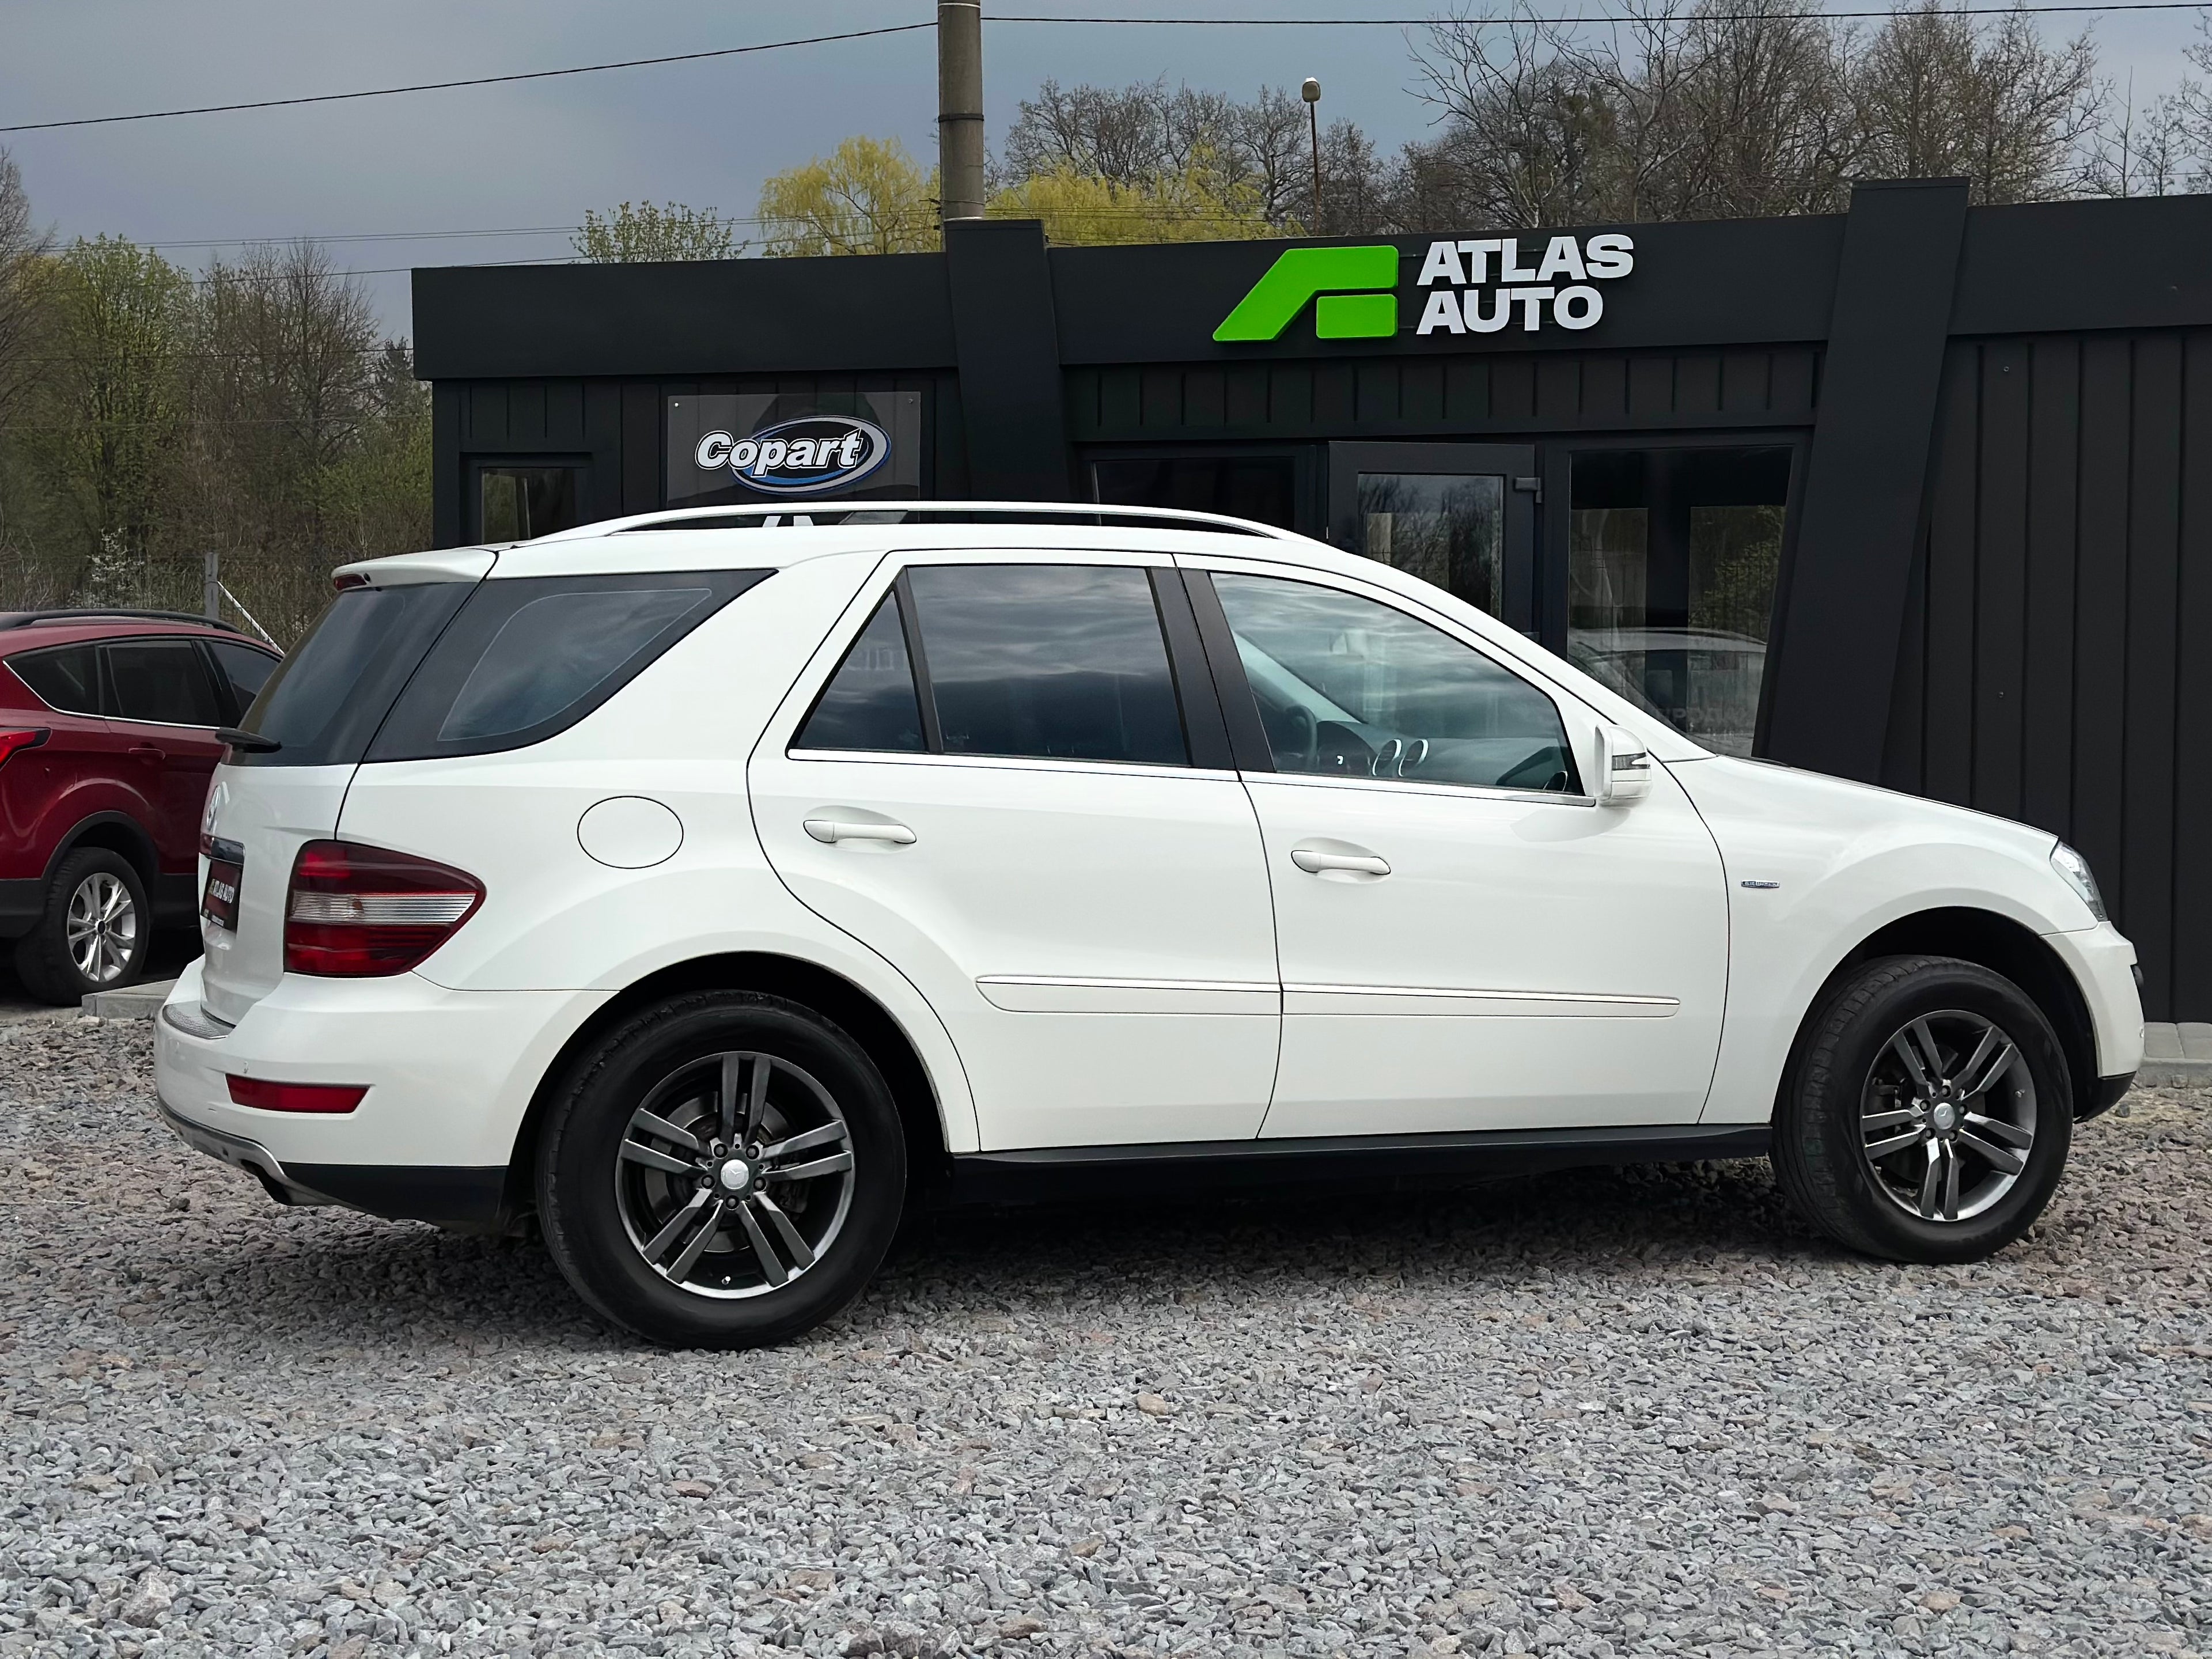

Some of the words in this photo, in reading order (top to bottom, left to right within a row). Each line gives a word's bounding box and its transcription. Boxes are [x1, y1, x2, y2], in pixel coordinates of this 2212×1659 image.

[1416, 234, 1634, 286] ATLAS
[1416, 286, 1603, 335] AUTO
[695, 429, 863, 478] Copart
